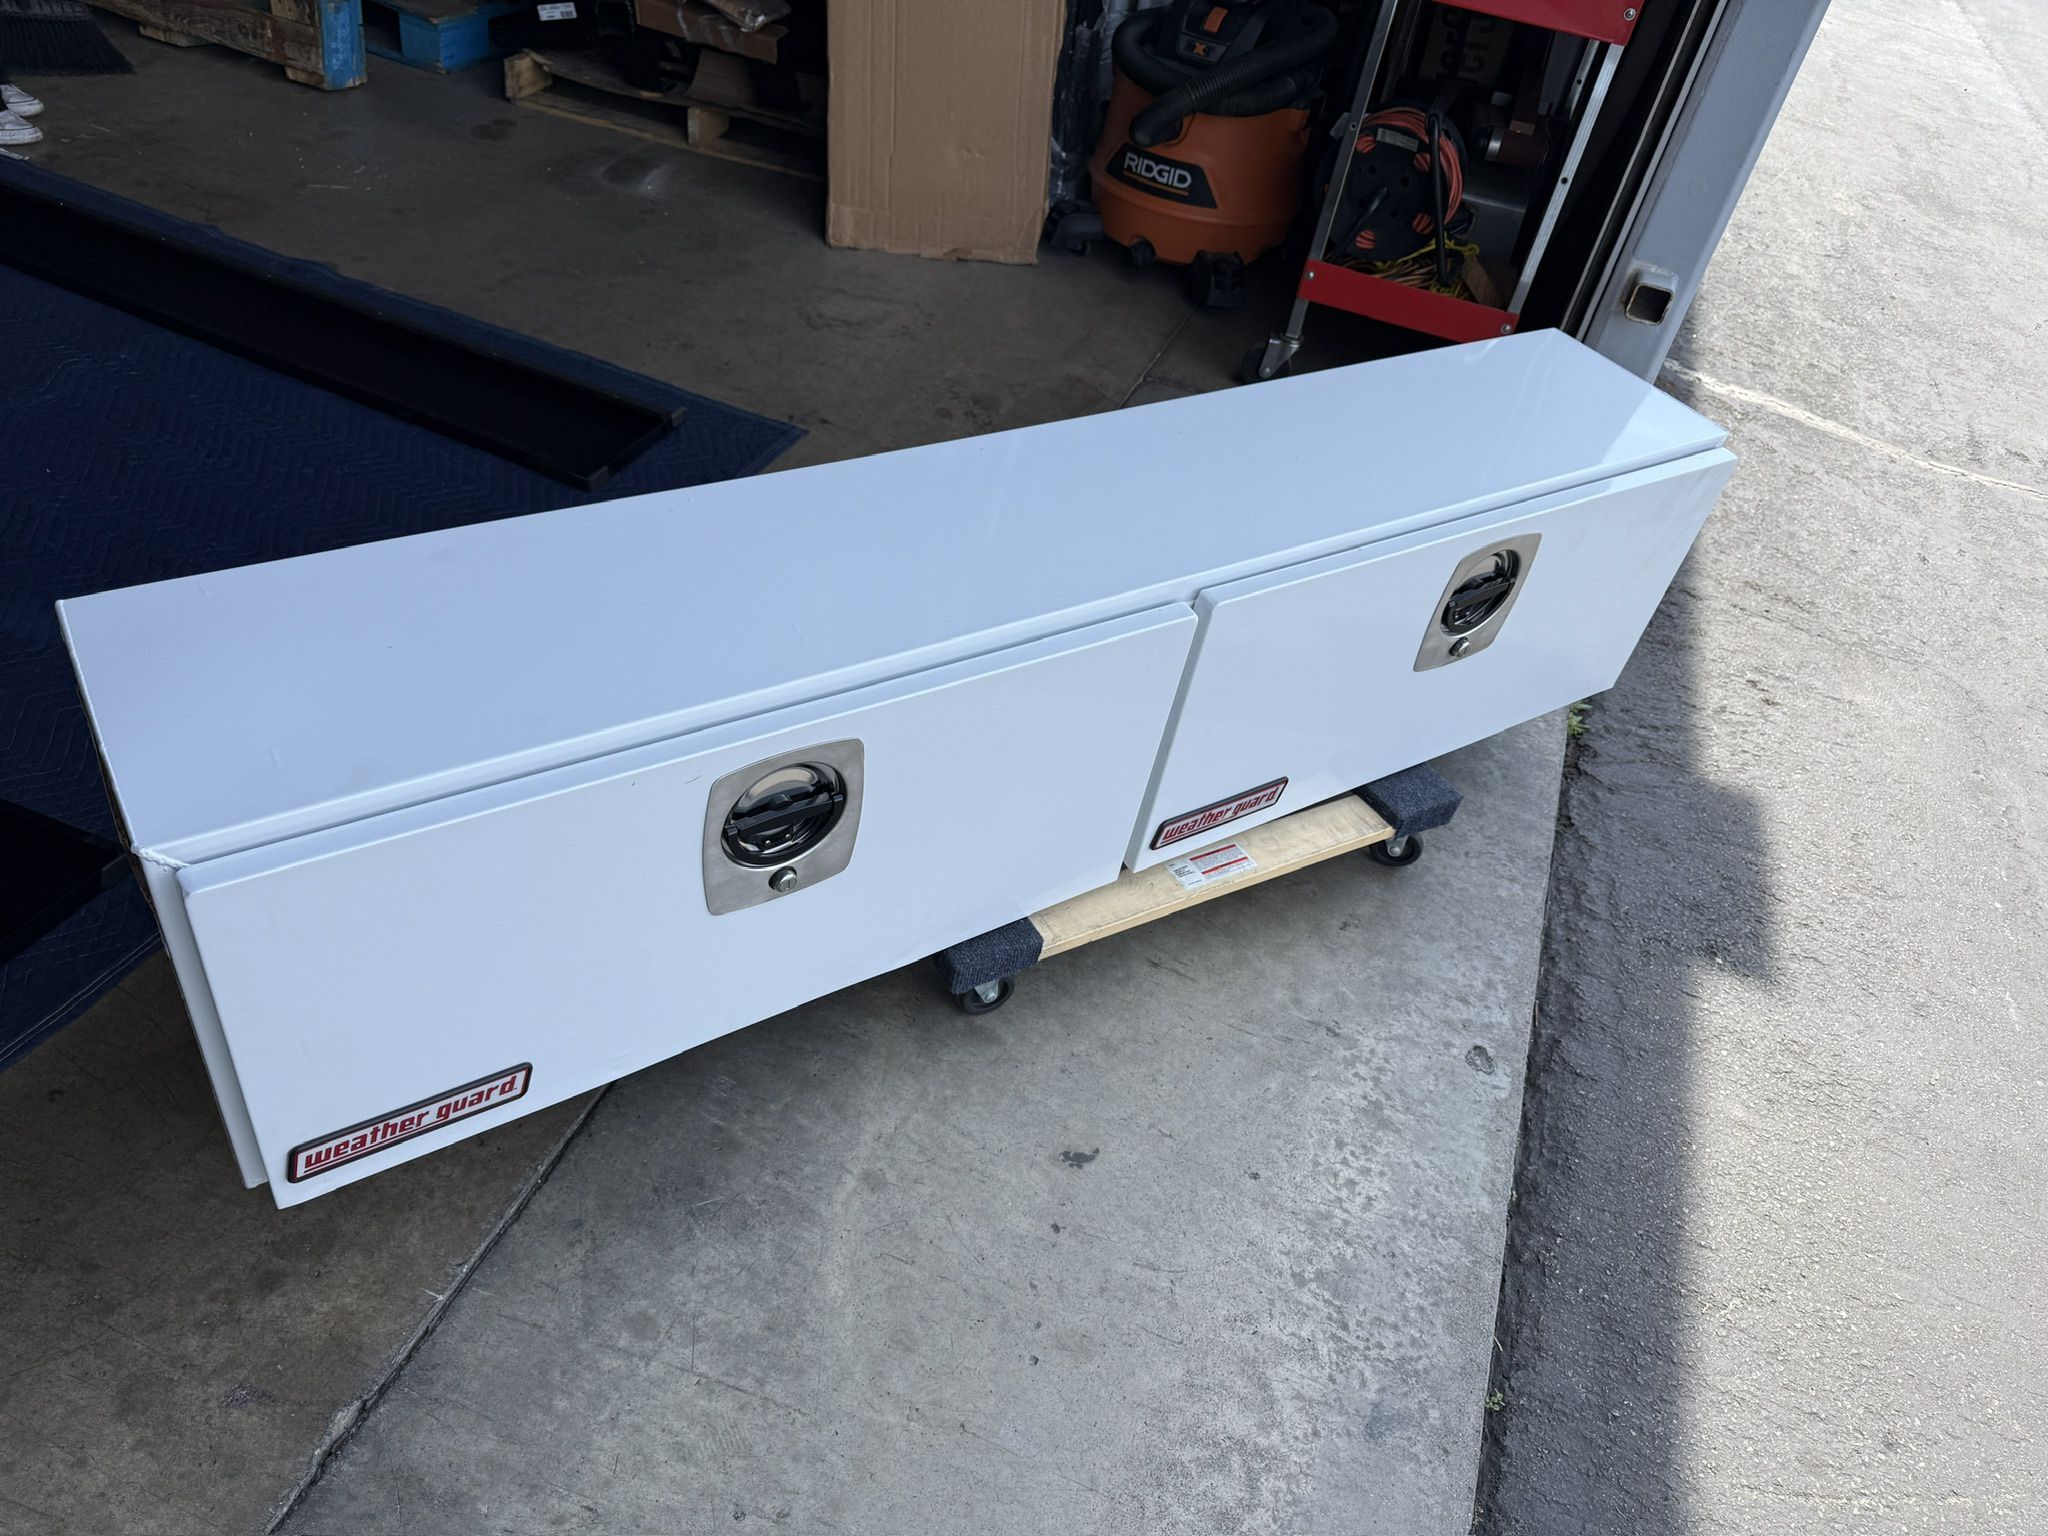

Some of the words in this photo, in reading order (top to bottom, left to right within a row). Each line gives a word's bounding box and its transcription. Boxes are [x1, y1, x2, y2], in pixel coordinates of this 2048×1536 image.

[1123, 151, 1192, 188] RIDGID
[1164, 808, 1232, 840] weather
[1231, 787, 1279, 817] guard
[305, 1110, 429, 1168] weather
[436, 1075, 517, 1119] guard
